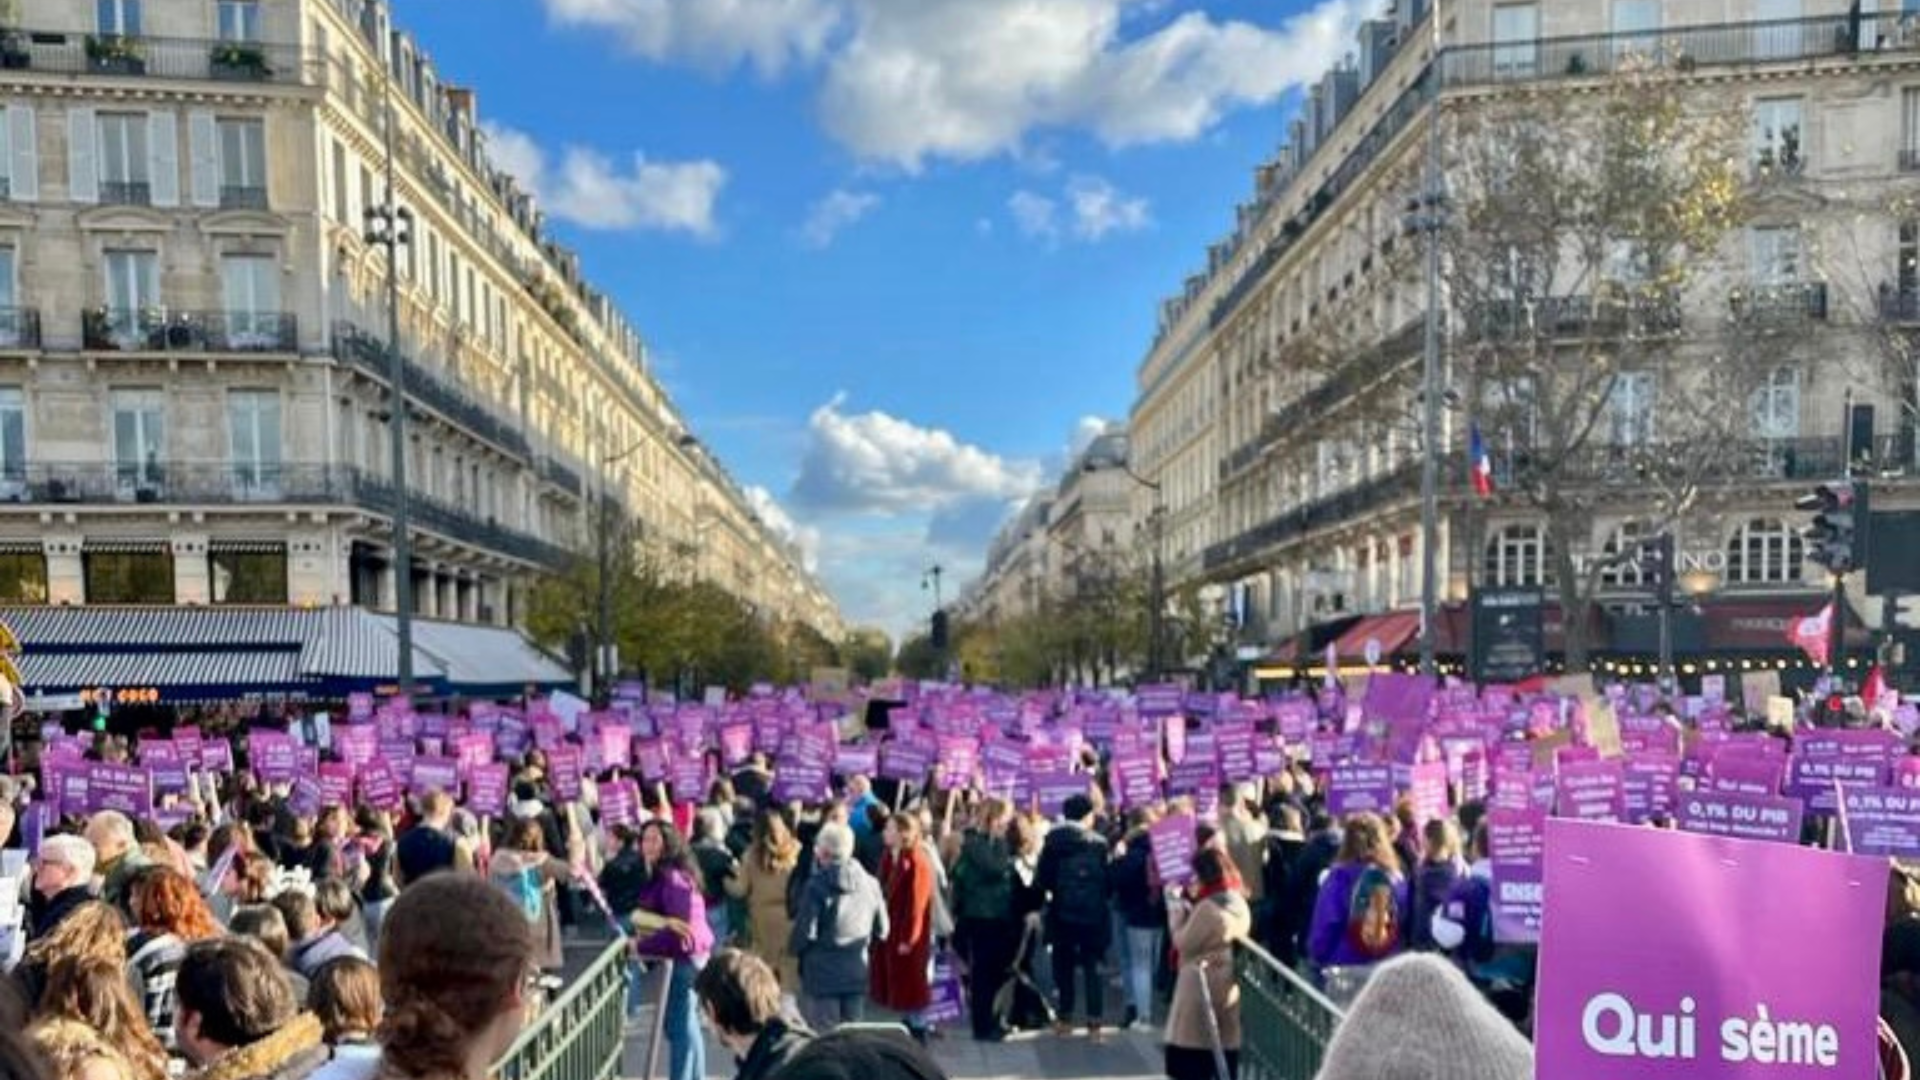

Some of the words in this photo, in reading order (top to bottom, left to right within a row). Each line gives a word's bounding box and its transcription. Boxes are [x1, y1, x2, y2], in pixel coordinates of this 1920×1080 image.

[1674, 550, 1726, 572] INO
[1687, 801, 1728, 819] 0,1%
[1731, 804, 1757, 821] DU
[1760, 808, 1788, 823] PIB
[1500, 882, 1542, 902] ENSE
[1582, 992, 1697, 1059] Qui
[1720, 1003, 1839, 1067] sème
